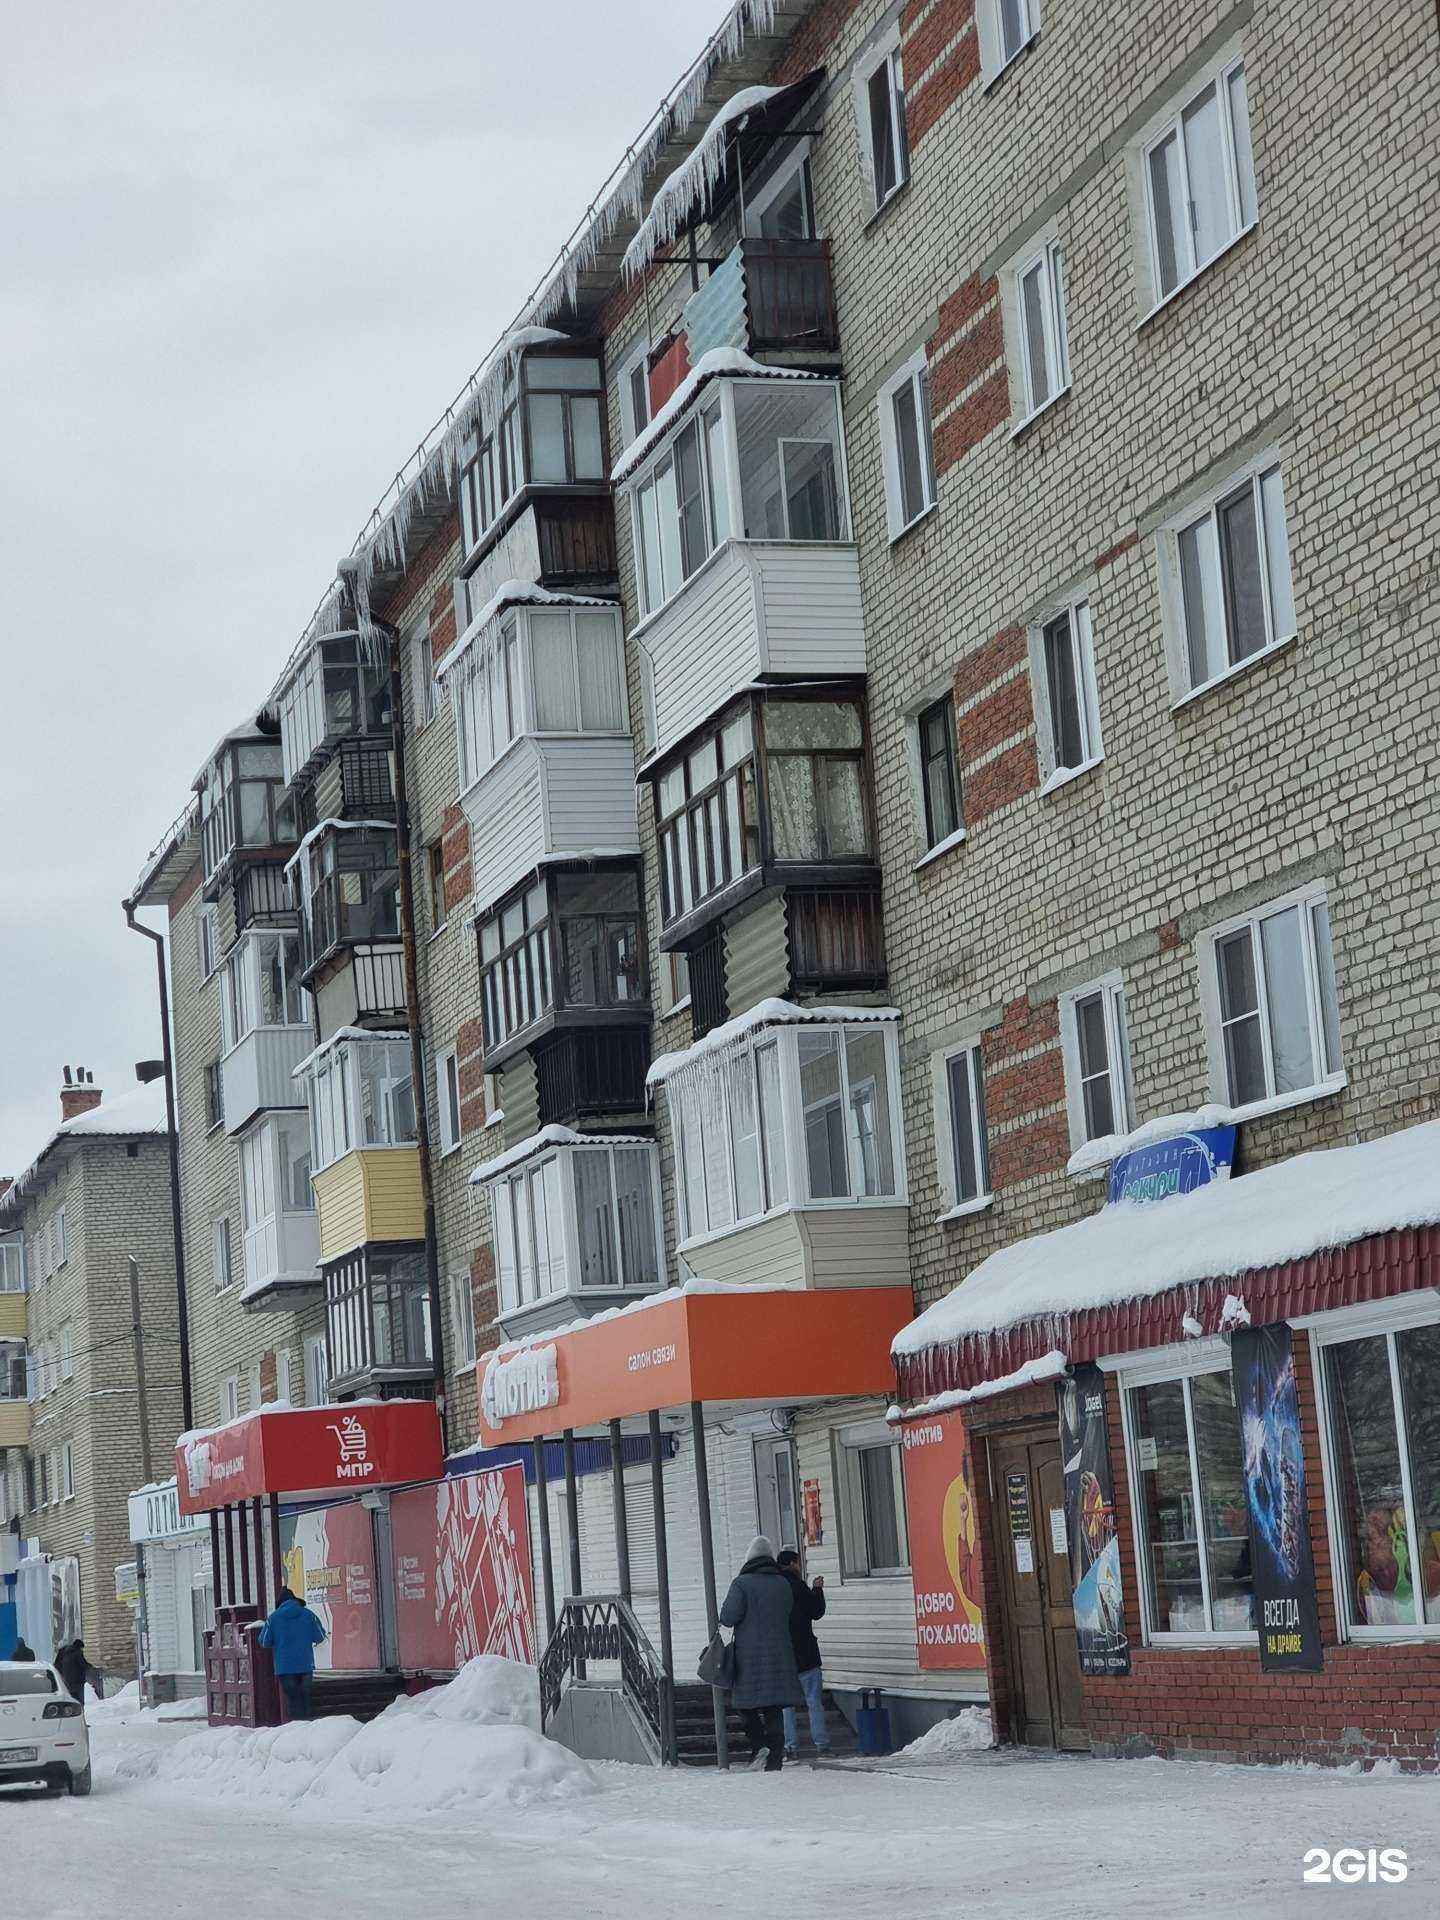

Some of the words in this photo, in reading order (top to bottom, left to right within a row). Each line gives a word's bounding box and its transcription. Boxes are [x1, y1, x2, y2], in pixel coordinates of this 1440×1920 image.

[628, 1352, 651, 1371] салон
[652, 1344, 676, 1365] связи
[495, 1344, 559, 1419] МОТИВ
[911, 1424, 943, 1445] МОТИВ
[336, 1461, 374, 1479] МПР
[146, 1490, 195, 1535] ОПТИ
[916, 1591, 954, 1617] ДОБРО
[1263, 1598, 1300, 1629] ВСЕГДА
[1267, 1635, 1277, 1654] НА
[1277, 1630, 1302, 1655] ДРАЙВЕ
